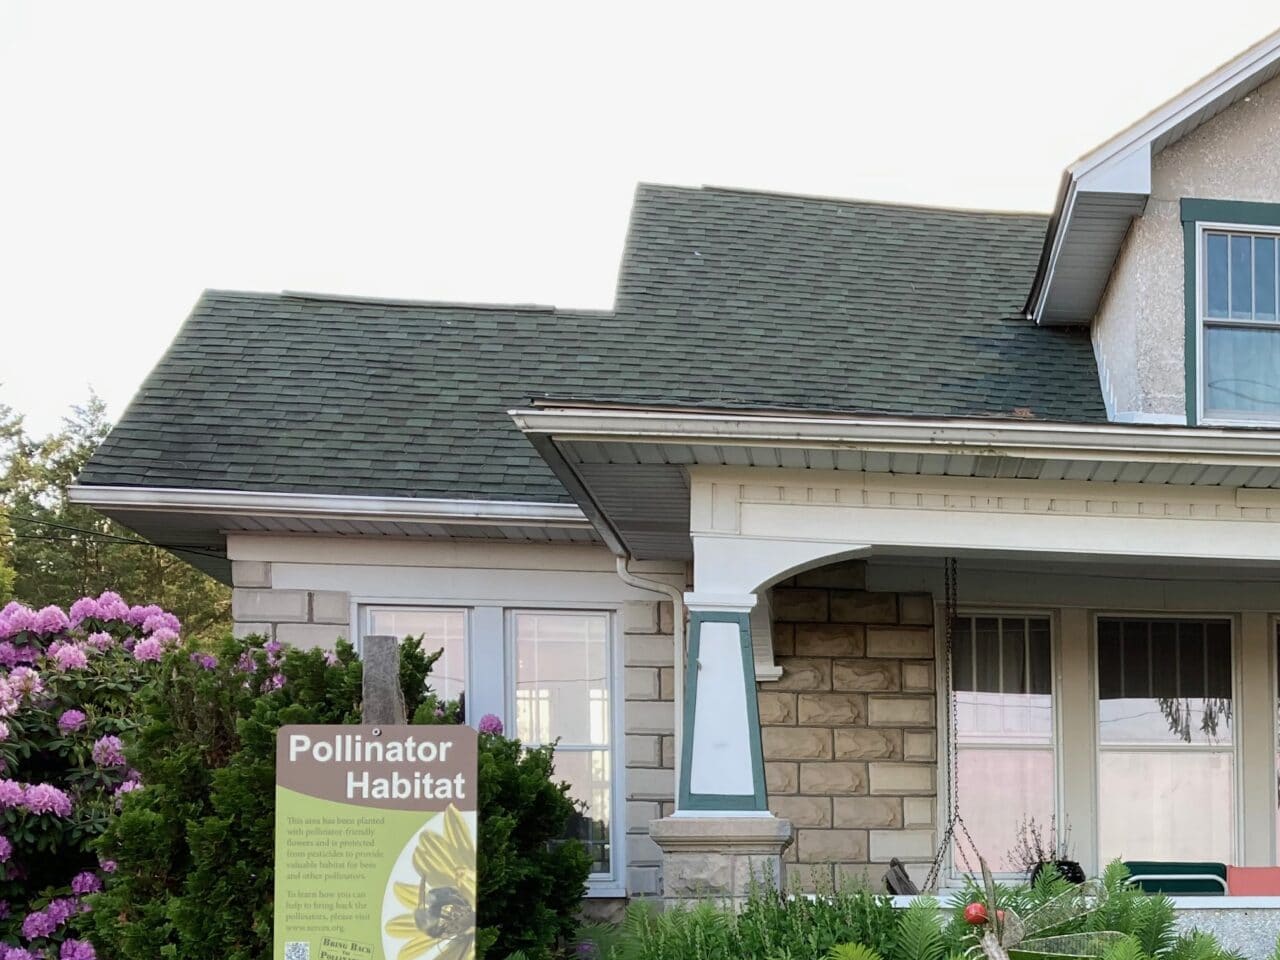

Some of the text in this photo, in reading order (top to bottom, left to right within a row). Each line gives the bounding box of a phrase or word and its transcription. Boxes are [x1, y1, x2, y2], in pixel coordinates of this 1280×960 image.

[289, 734, 453, 762] Pollinator
[346, 771, 466, 799] Habitat
[288, 816, 385, 827] This area has been planted
[287, 827, 304, 836] with
[287, 838, 375, 849] flowers and is protected
[287, 850, 306, 858] from
[306, 850, 344, 860] pesticides
[355, 849, 384, 860] provide
[287, 860, 377, 869] valuable habitat for bees
[287, 871, 367, 882] and other pollinators.
[287, 889, 366, 900] To learn how you can
[285, 900, 367, 911] help to bring back the
[285, 911, 370, 922] pollinators, please visit
